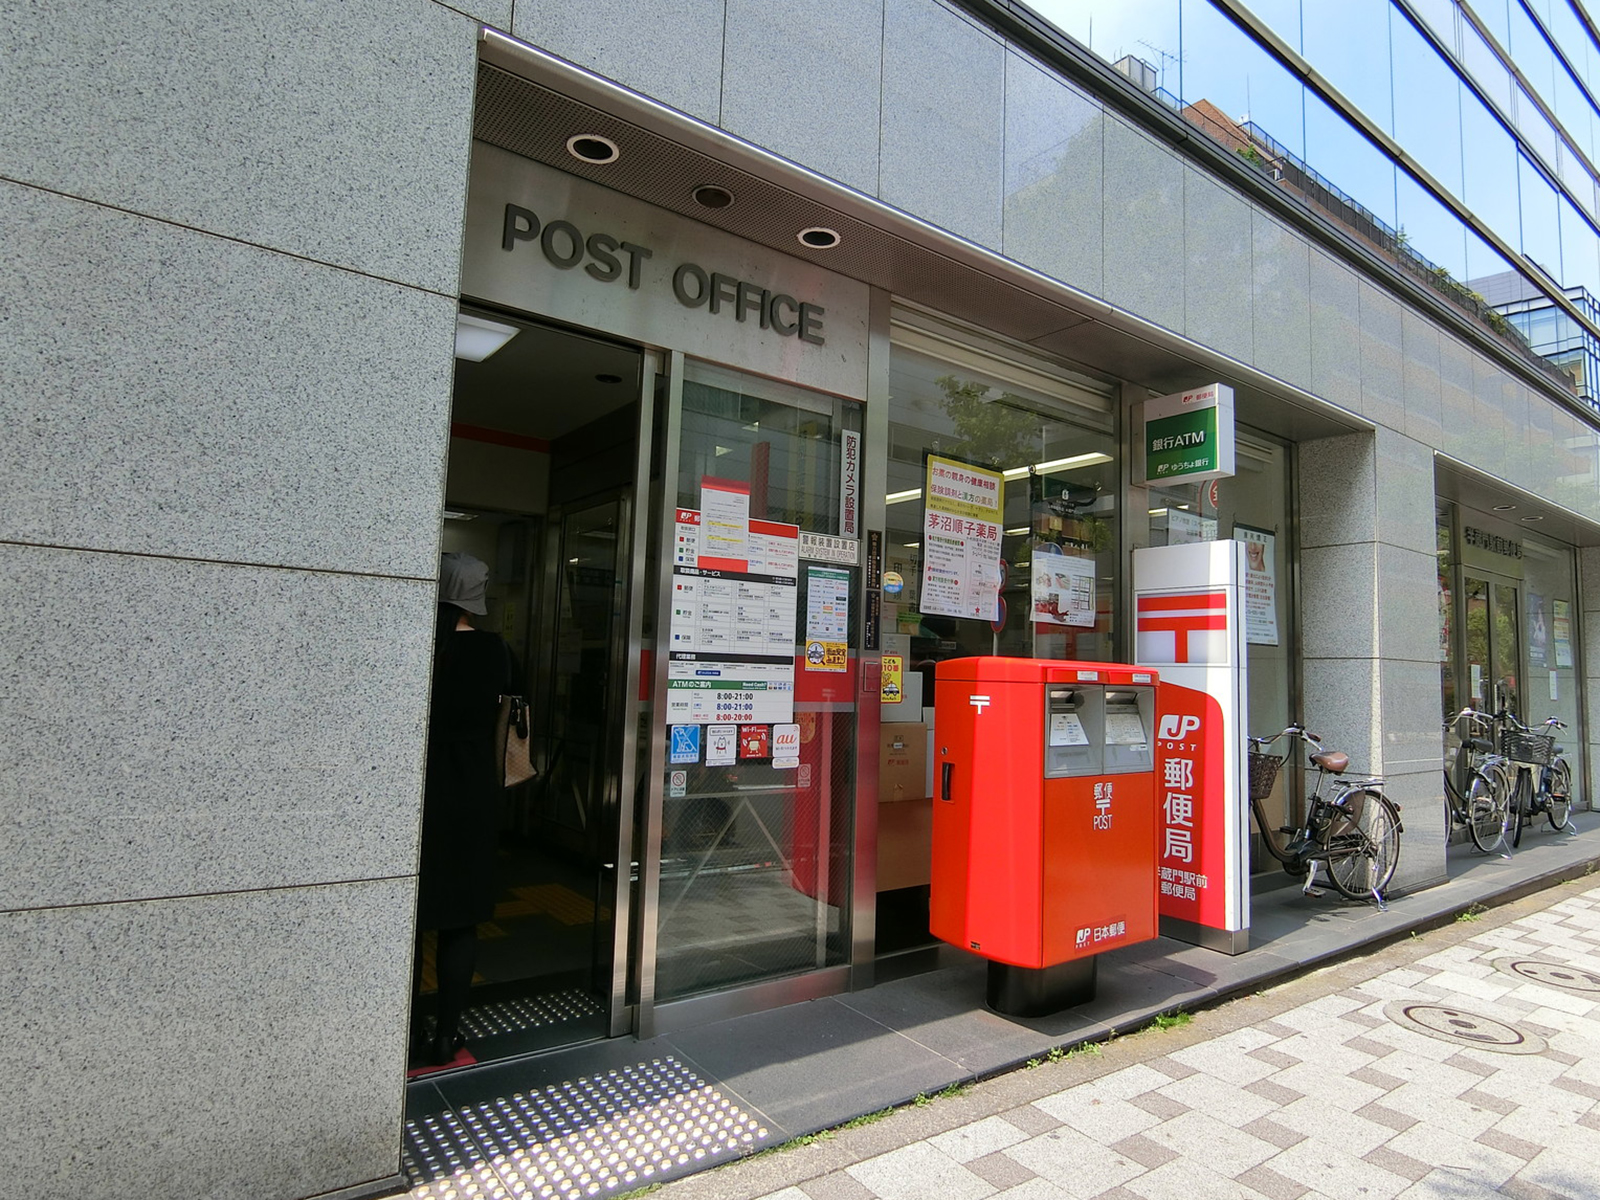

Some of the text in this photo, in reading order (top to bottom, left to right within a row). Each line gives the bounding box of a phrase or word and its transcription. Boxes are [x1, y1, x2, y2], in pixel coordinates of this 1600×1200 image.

[502, 203, 825, 345] POST OFFICE
[1152, 430, 1205, 452] 銀行ATM
[1171, 458, 1209, 471] ゆうちょ銀行
[844, 435, 857, 534] 防犯カメラ設置局
[928, 513, 998, 541] 茅沼順子薬局
[802, 535, 855, 551] 警報装置設置店
[672, 680, 712, 689] ATMのご案内
[717, 692, 754, 701] 8:00-21:00
[716, 703, 753, 711] 8:00-21:00
[716, 713, 753, 721] 8:00-20:00
[1158, 714, 1200, 740] JP
[776, 734, 797, 744] au
[1157, 741, 1197, 752] POST
[1093, 782, 1113, 800] 郵便
[1163, 757, 1194, 863] 郵便局
[1093, 815, 1112, 830] POST
[1160, 881, 1196, 901] 郵便局
[1076, 921, 1125, 944] JP 日本郵便
